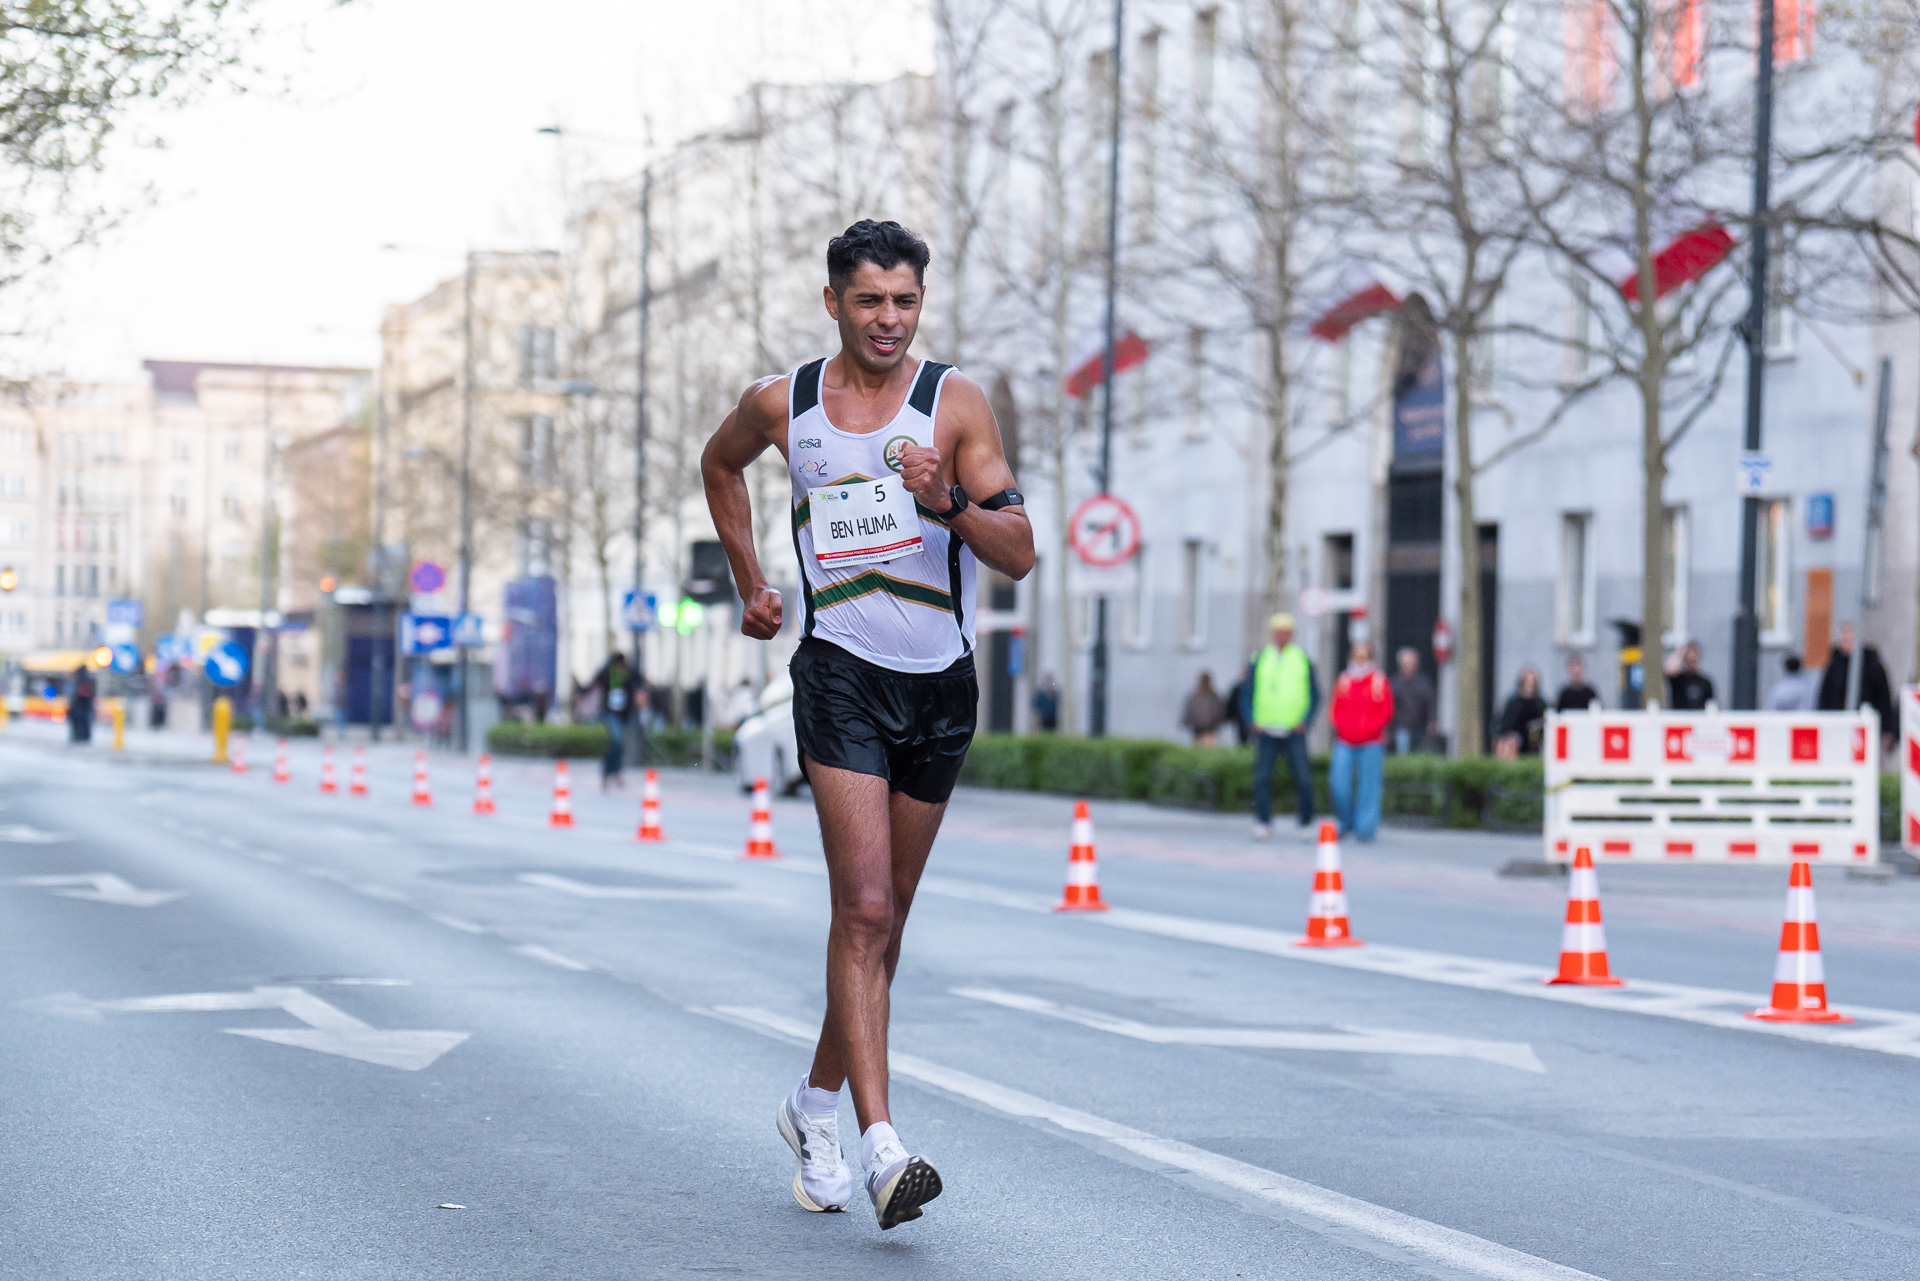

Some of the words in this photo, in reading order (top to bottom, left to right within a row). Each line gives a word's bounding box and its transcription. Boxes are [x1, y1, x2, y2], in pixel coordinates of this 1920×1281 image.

[798, 438, 822, 449] esa
[875, 484, 886, 502] 5
[830, 520, 854, 539] BEN
[857, 513, 897, 536] HLIMA
